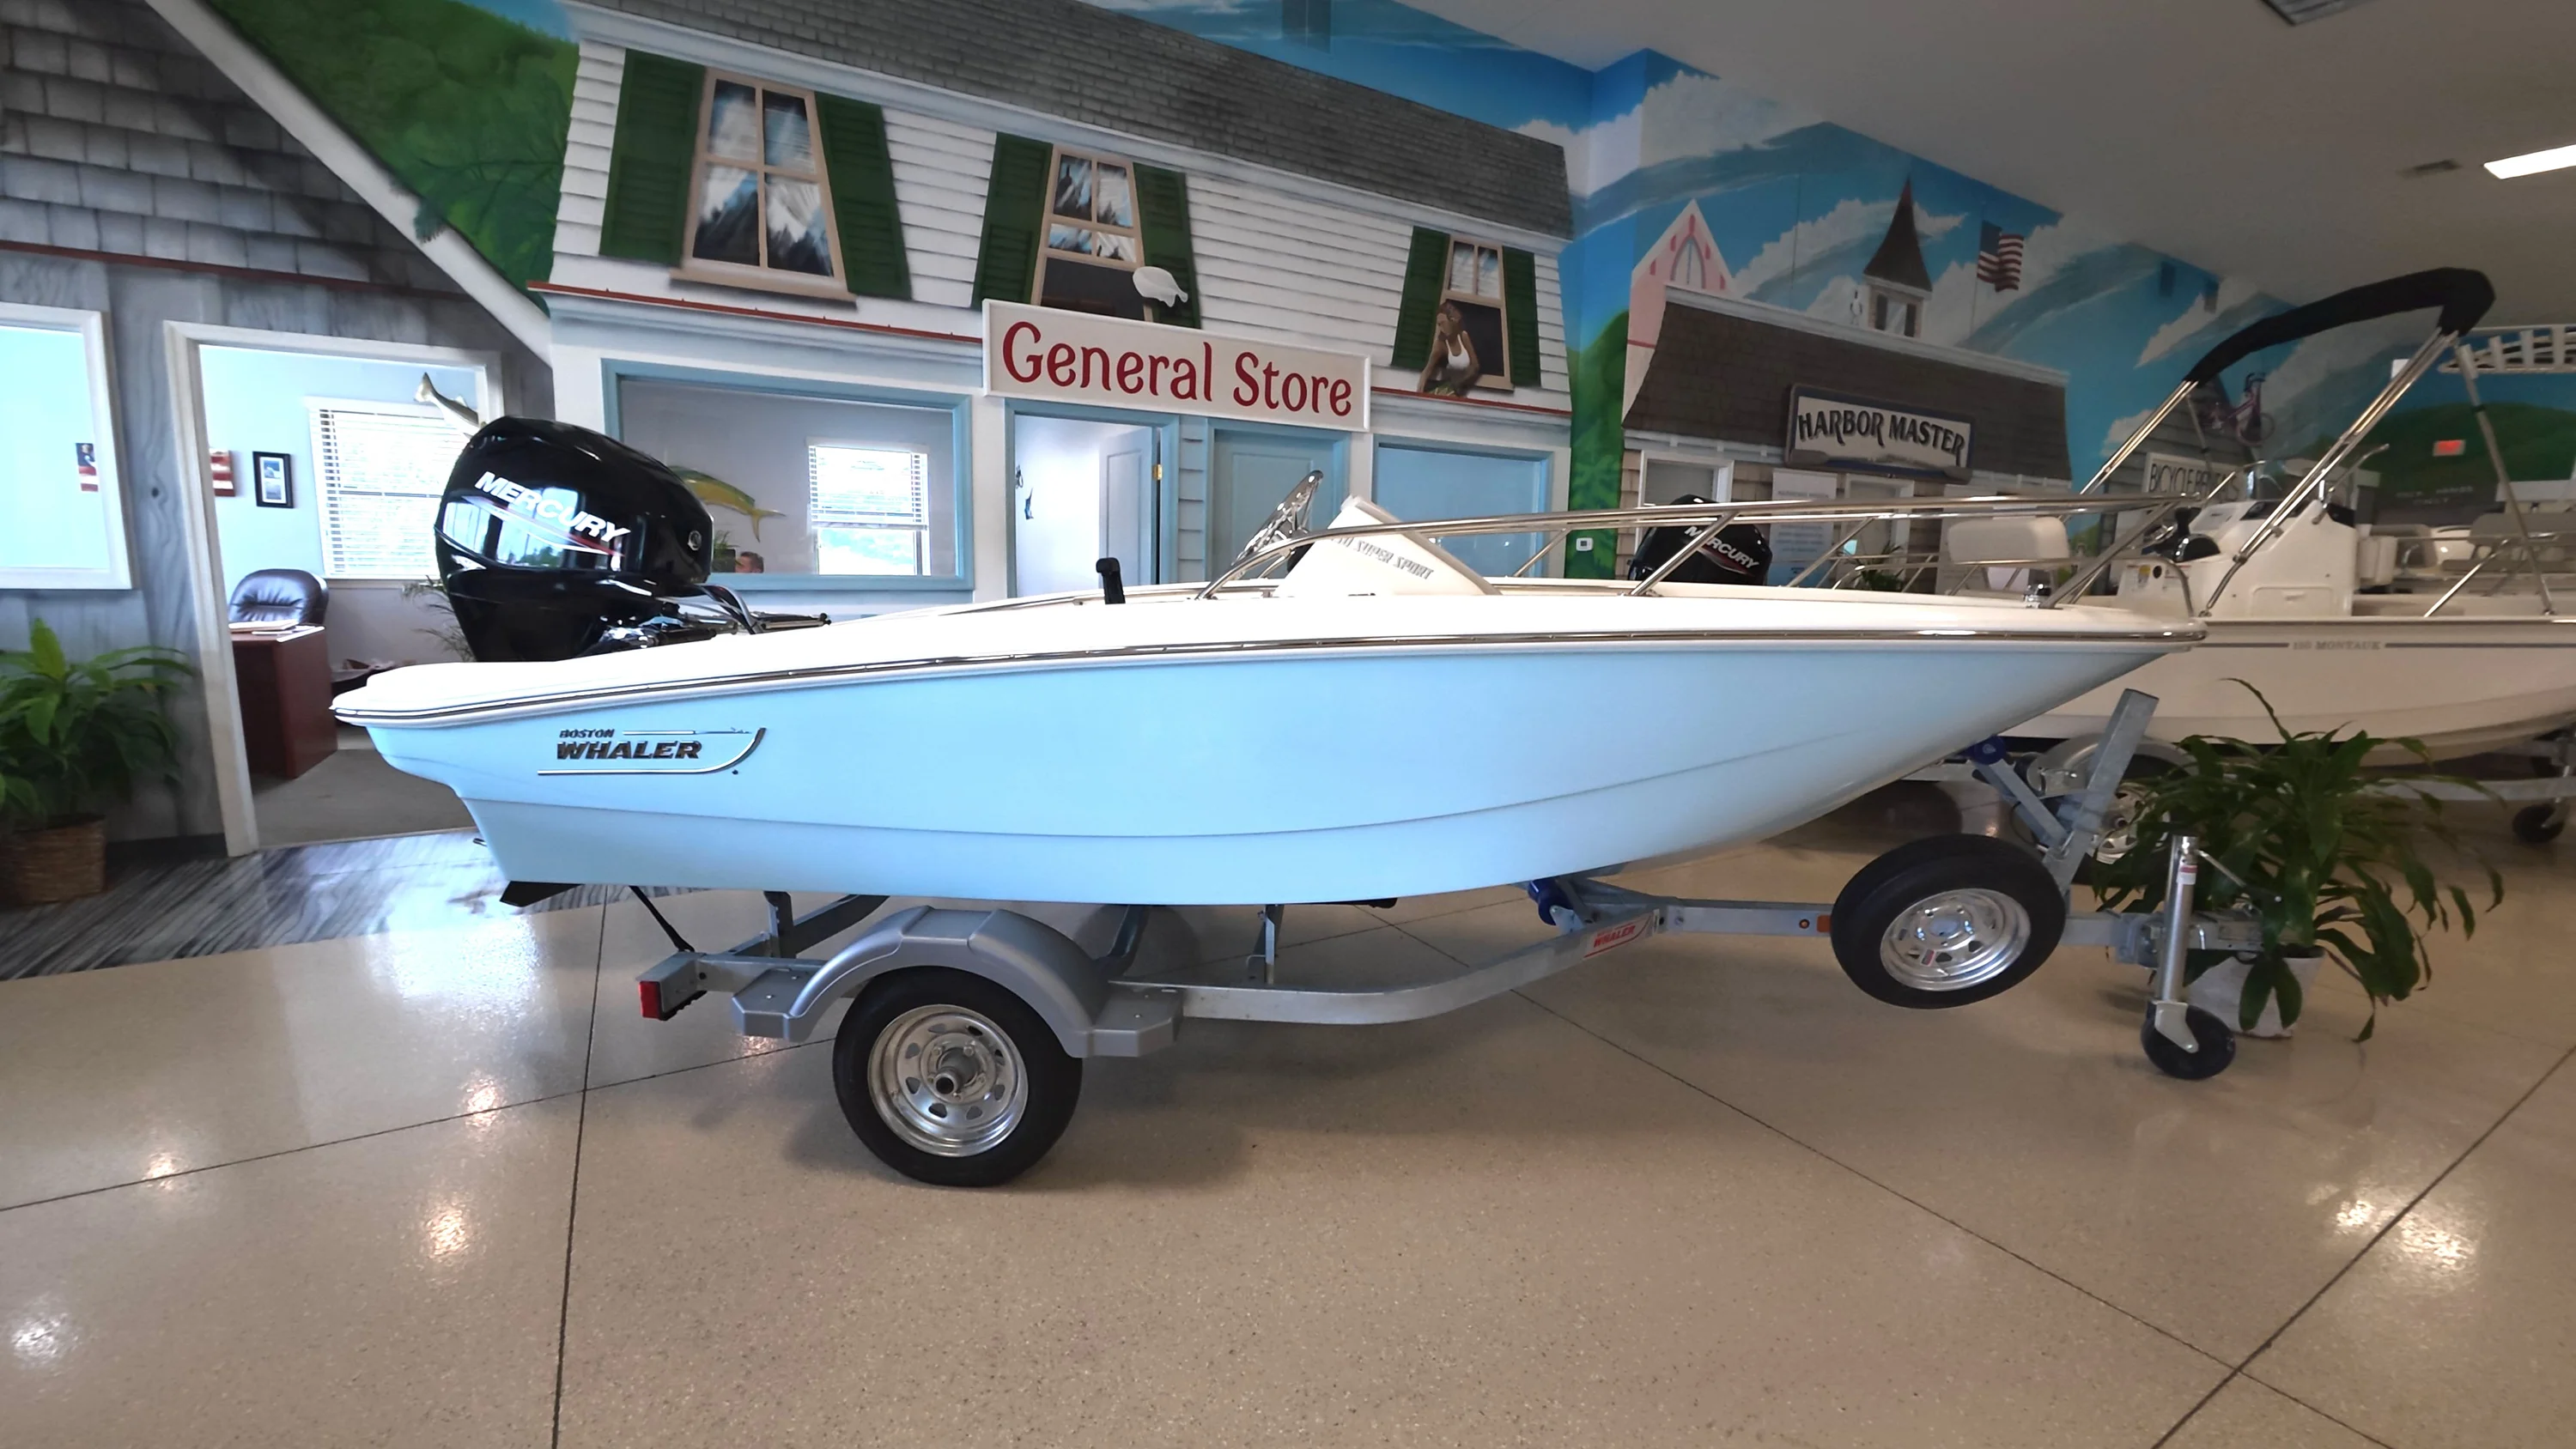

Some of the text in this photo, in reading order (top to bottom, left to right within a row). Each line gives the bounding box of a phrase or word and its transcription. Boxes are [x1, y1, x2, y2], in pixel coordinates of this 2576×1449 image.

[1003, 321, 1352, 417] General Store
[1797, 409, 1965, 467] HARBOR MASTER
[475, 471, 631, 542] MERCURY
[1353, 540, 1394, 564] SUPER
[1393, 556, 1434, 580] SPORT
[1684, 525, 1759, 568] MRCURY
[556, 740, 702, 760] WHALER
[559, 728, 615, 739] BOSTON
